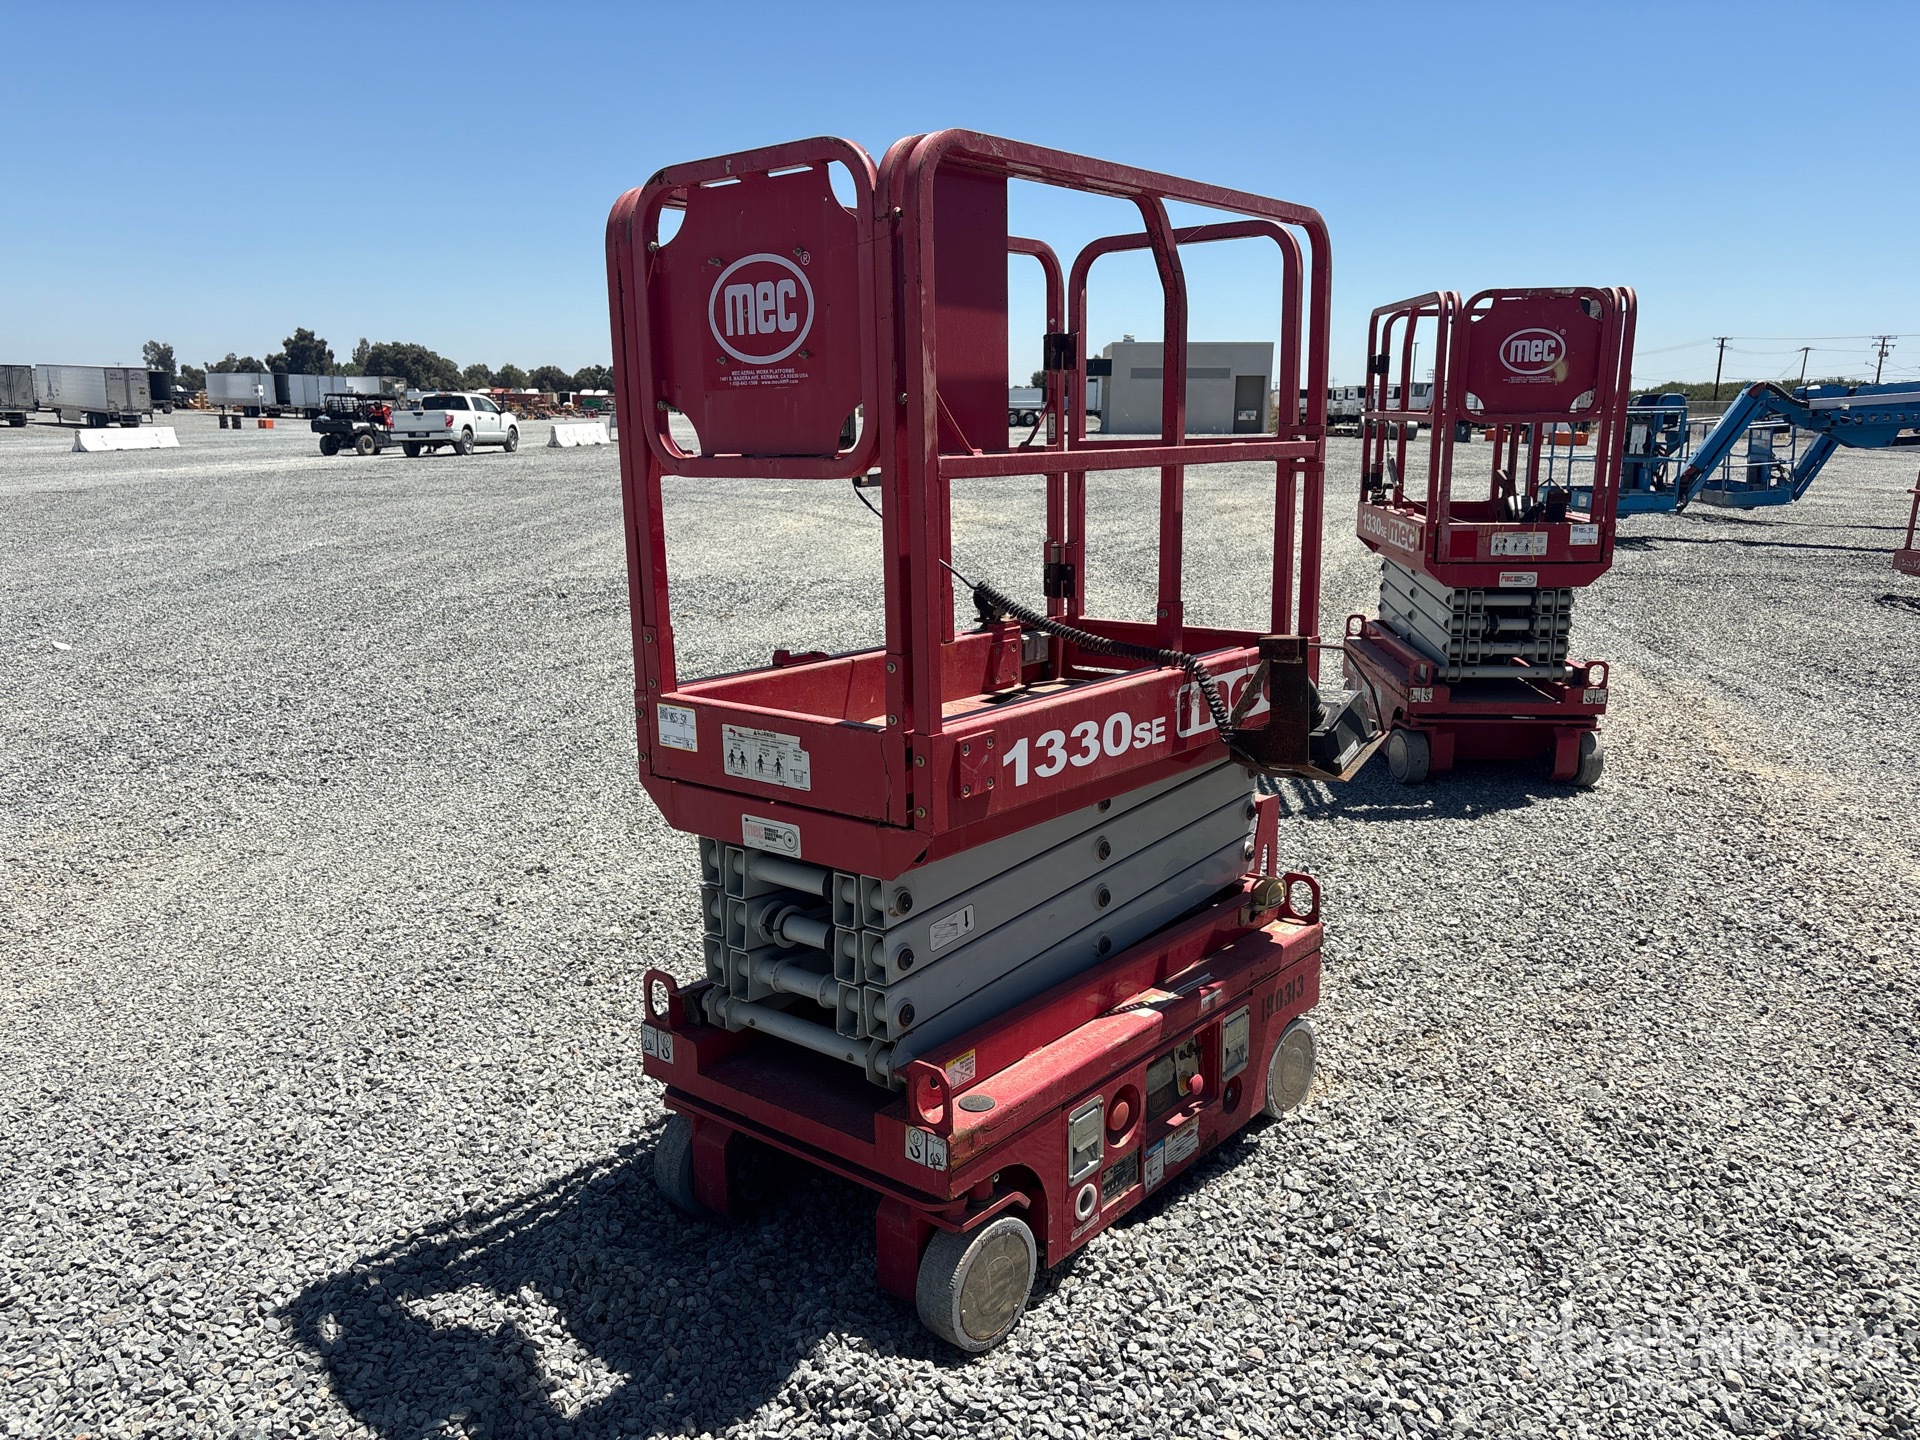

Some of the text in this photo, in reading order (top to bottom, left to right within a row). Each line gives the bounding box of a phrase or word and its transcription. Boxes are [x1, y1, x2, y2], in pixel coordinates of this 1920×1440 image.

[725, 279, 797, 336] mec
[1510, 340, 1556, 362] mec
[1003, 711, 1166, 787] 1330SE
